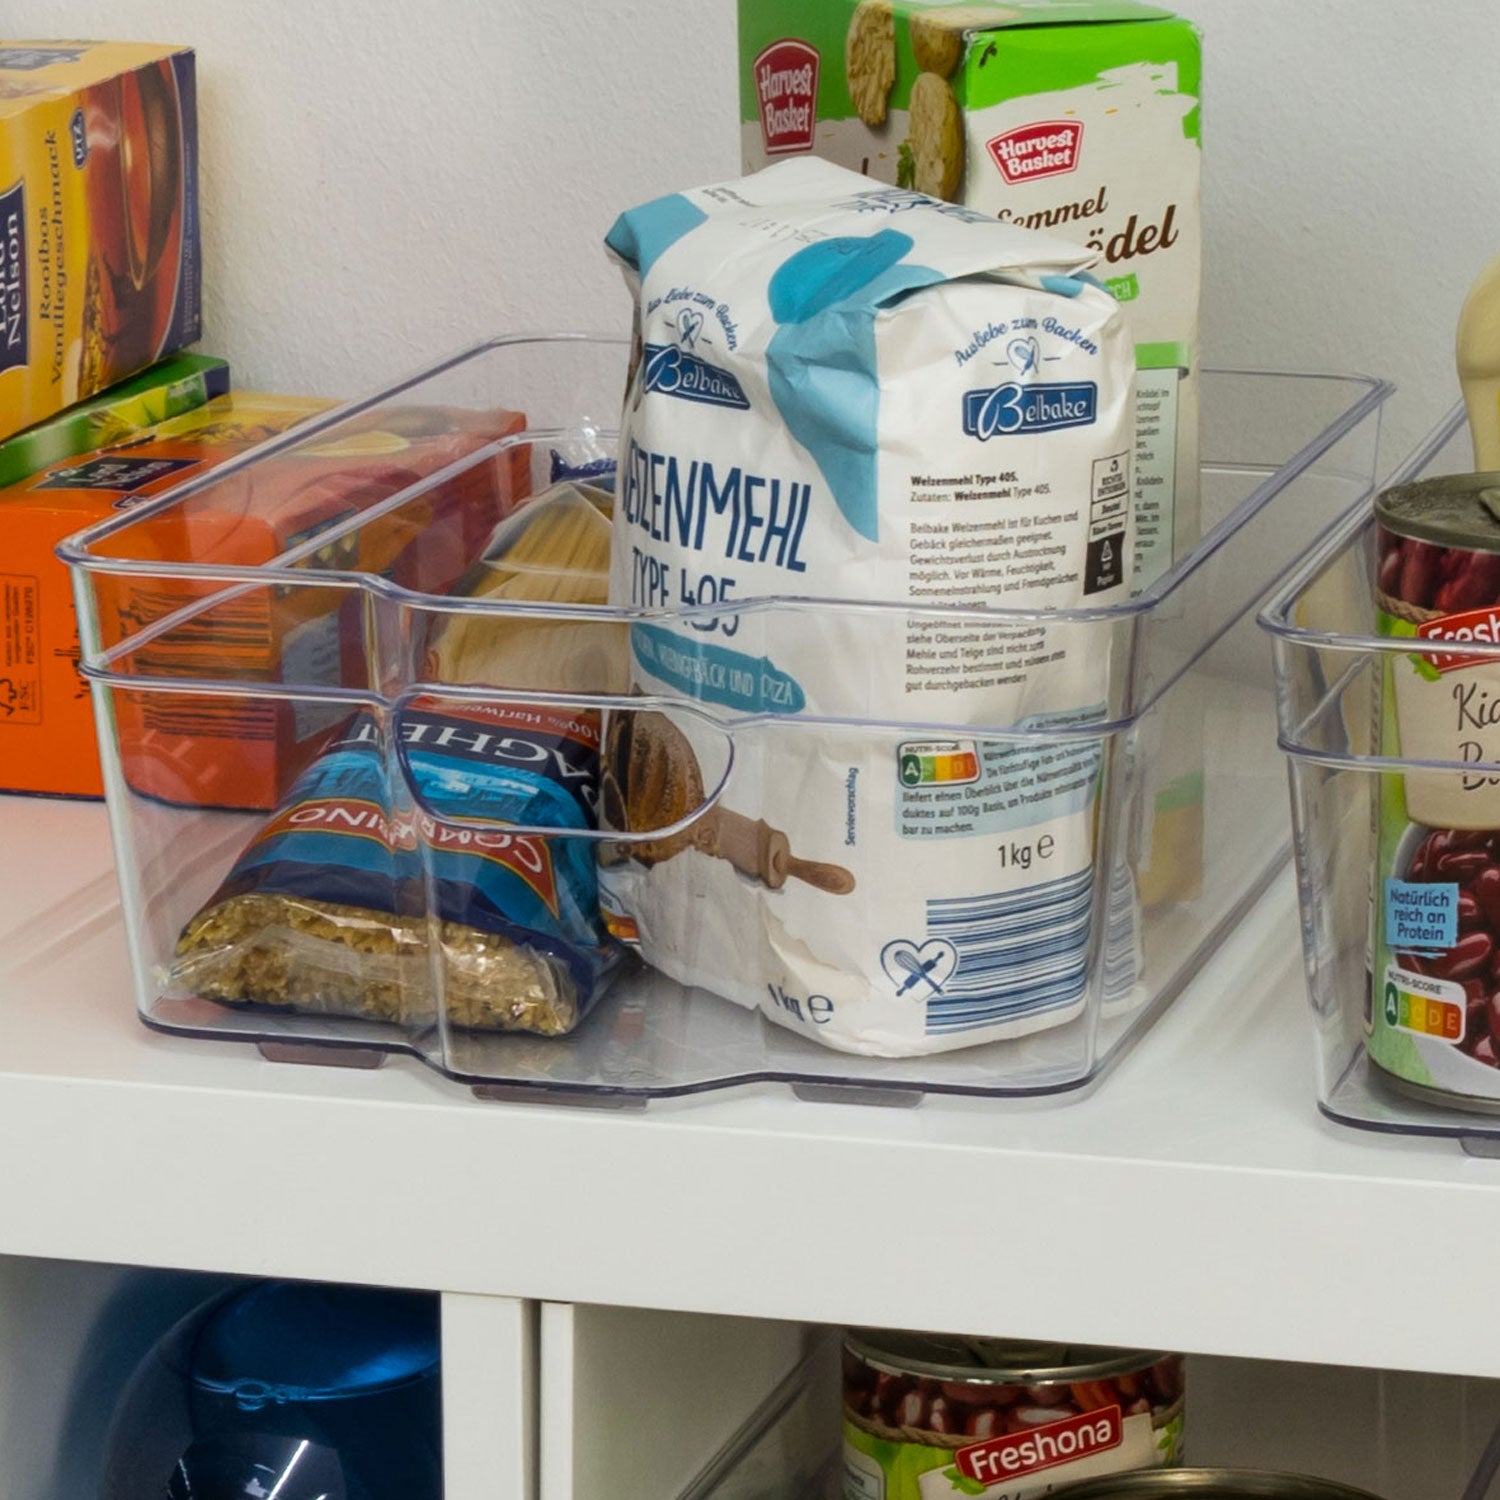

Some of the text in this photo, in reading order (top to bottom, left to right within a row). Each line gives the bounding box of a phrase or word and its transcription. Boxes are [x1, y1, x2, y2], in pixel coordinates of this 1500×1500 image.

[761, 59, 814, 100] Harvest
[764, 98, 811, 139] Basket
[998, 129, 1076, 160] Harvest
[1007, 149, 1072, 177] Basket
[998, 186, 1109, 231] Semmel
[1085, 204, 1180, 270] ödel
[38, 206, 51, 321] Rooibos
[45, 130, 67, 385] Vanillegeschmack
[6, 211, 20, 350] Nelson
[1041, 316, 1099, 356] Backen
[977, 382, 1087, 440] Belbake
[911, 475, 974, 487] Weizenmehl
[975, 474, 997, 486] Type
[954, 487, 1012, 501] Weizenmehl
[622, 438, 811, 573] EIZENMEHL
[910, 522, 950, 535] Belbake
[910, 537, 946, 551] Gebäck
[986, 550, 1012, 562] durch
[909, 569, 950, 583] möglich.
[935, 632, 980, 645] Oberseite
[906, 649, 937, 660] Mehle
[939, 648, 958, 659] und
[960, 646, 984, 660] Teige
[986, 645, 1004, 656] sind
[906, 659, 1022, 675] Rohverzehr bestimmt und
[905, 677, 995, 693] gut durchgebacken
[904, 762, 919, 776] A
[903, 790, 933, 802] liefert
[935, 790, 962, 801] einen
[845, 767, 859, 847] Serviervorschlag
[902, 807, 936, 819] duktes
[939, 806, 955, 817] auf
[957, 805, 980, 817] 100g
[902, 824, 919, 835] bar
[920, 825, 933, 835] zu
[1390, 889, 1449, 908] Natürlich
[1394, 908, 1446, 924] reich an
[1397, 923, 1444, 941] Protein
[1387, 970, 1442, 995] NUTRI-SCORE
[1386, 992, 1397, 1016] A
[970, 1418, 1112, 1480] Freshona
